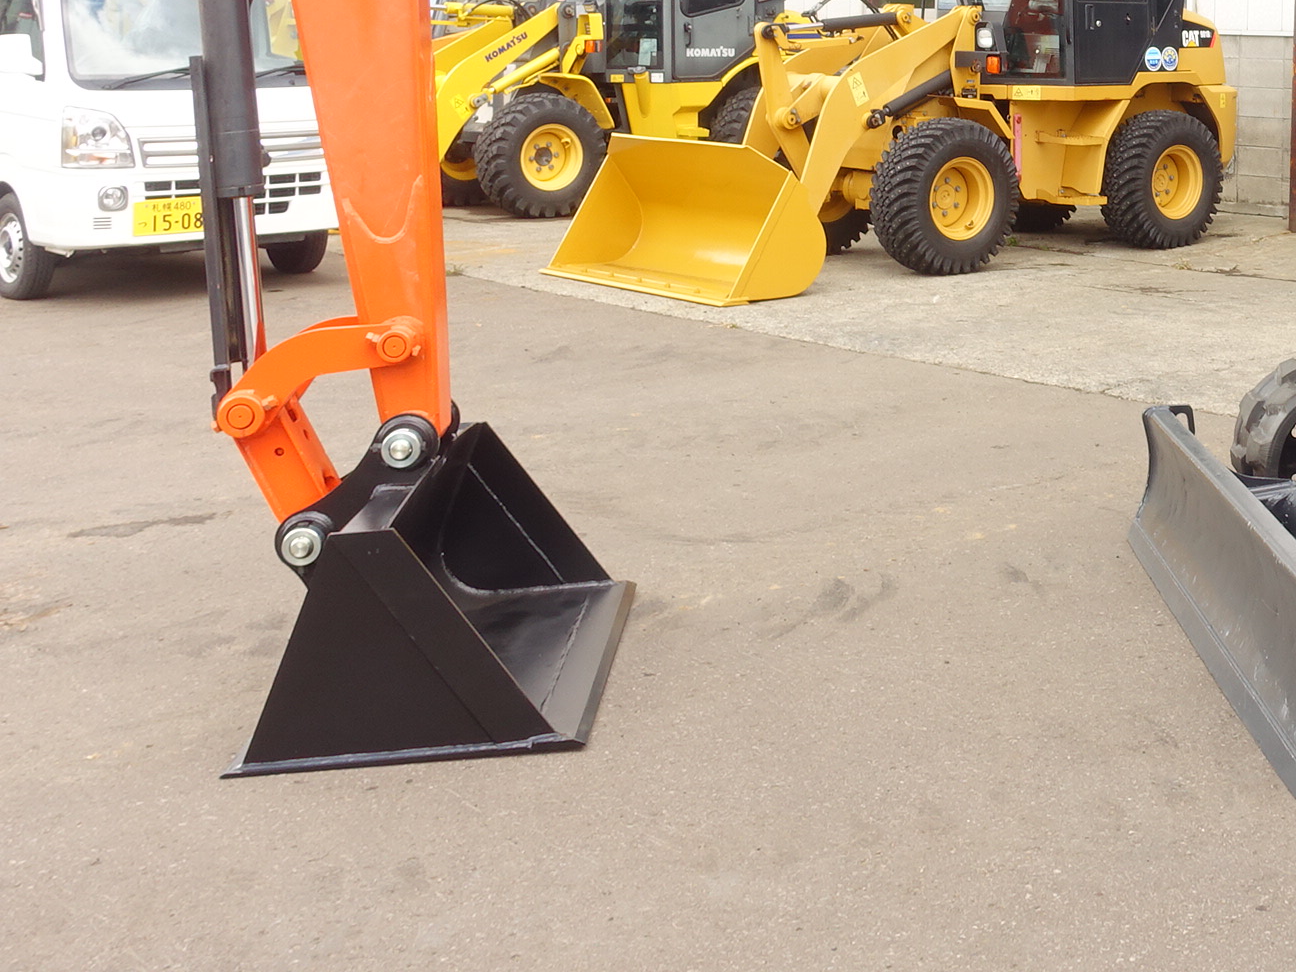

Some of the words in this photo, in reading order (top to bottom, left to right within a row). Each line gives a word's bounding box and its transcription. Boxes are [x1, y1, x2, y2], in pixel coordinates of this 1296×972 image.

[1181, 29, 1199, 47] CAT
[485, 31, 528, 62] KOMATSU
[686, 45, 736, 57] KOMATSU
[173, 201, 191, 211] 480
